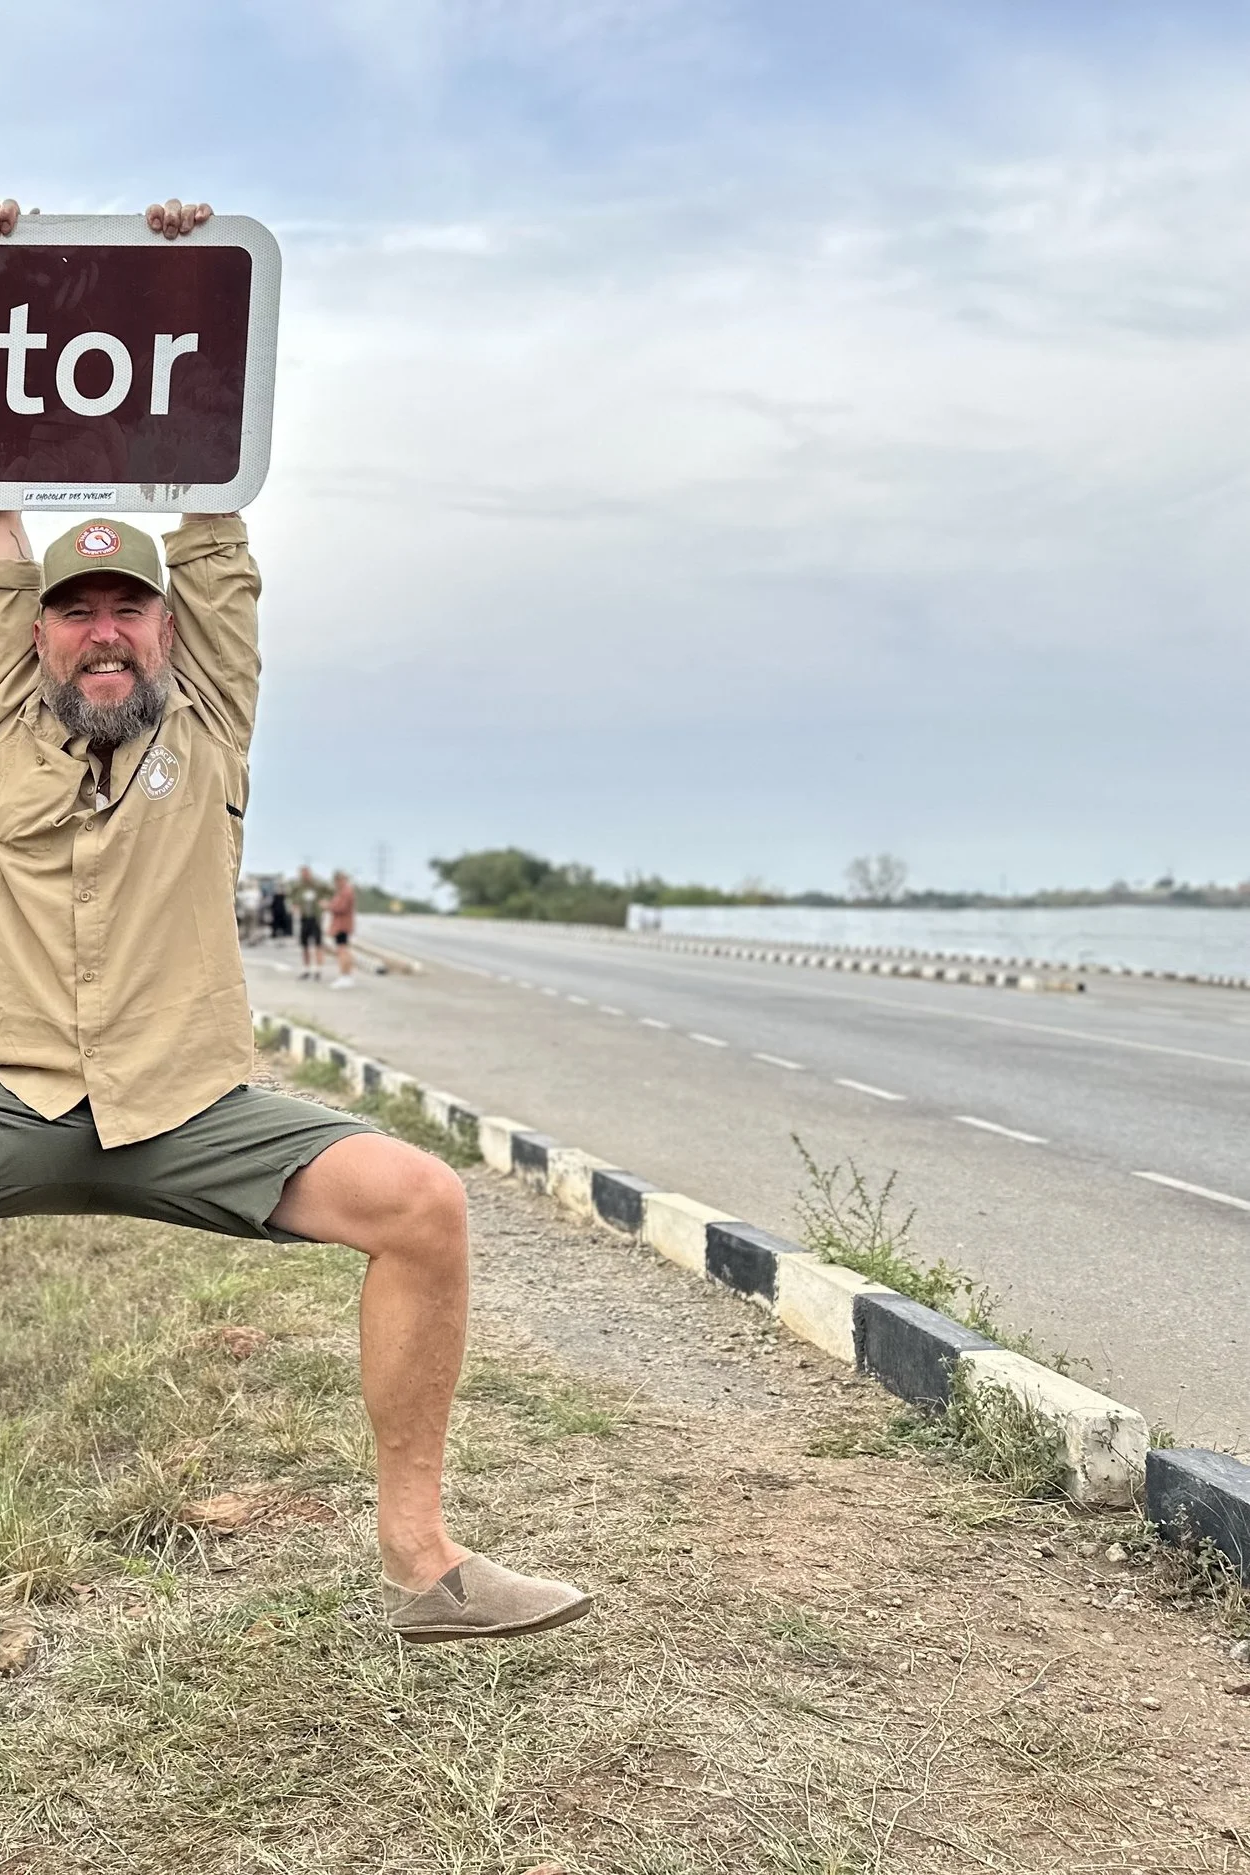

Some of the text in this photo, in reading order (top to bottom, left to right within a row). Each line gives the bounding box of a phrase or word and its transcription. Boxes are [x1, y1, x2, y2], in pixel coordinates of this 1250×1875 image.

[25, 491, 113, 501] LE CHOCOLAT DES YVELINES
[140, 758, 151, 775] THE
